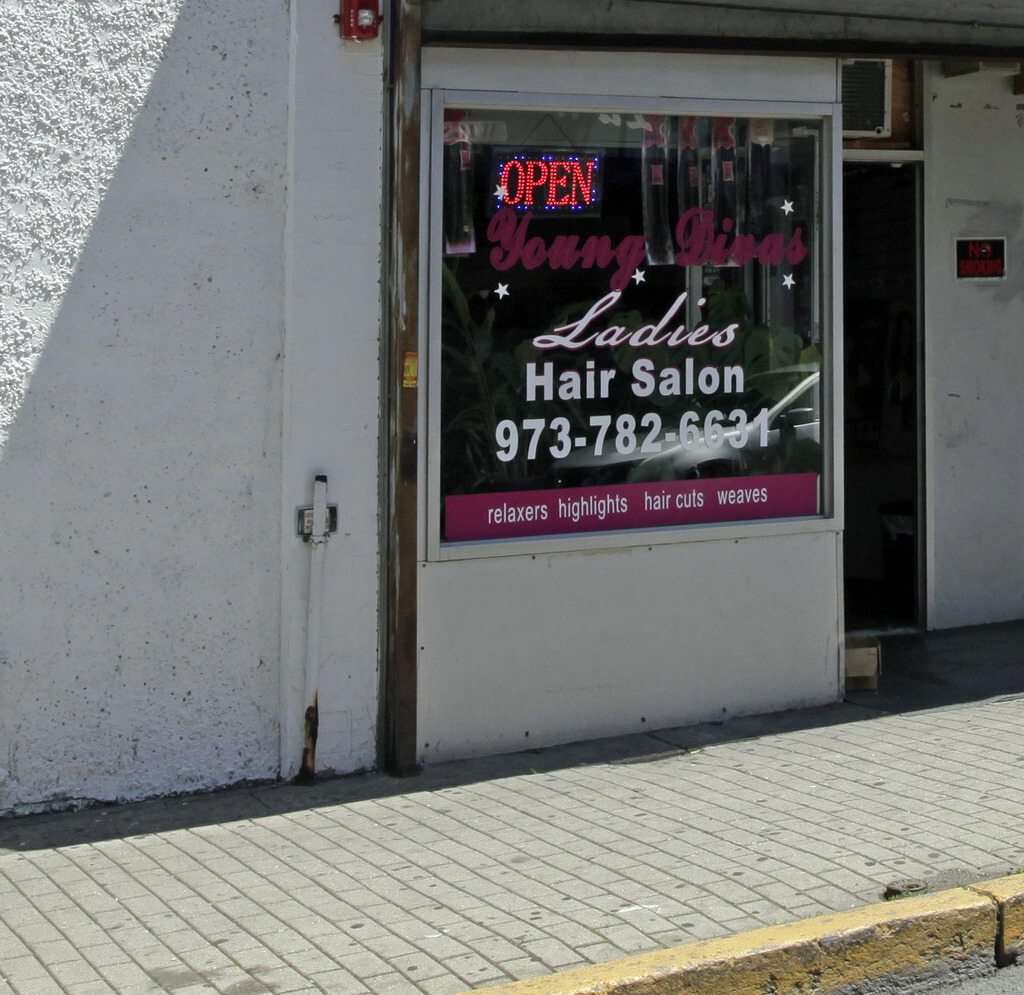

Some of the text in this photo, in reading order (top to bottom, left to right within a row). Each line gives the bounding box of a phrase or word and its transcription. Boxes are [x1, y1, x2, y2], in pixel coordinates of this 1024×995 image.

[500, 160, 593, 206] OPEN
[487, 208, 808, 291] Young Divas
[968, 242, 994, 258] NO
[532, 290, 739, 348] Ladies
[525, 357, 745, 402] Hair Salon
[496, 409, 770, 462] 973-782-6631
[488, 486, 768, 525] relaxers highlights hair cuts weaves
